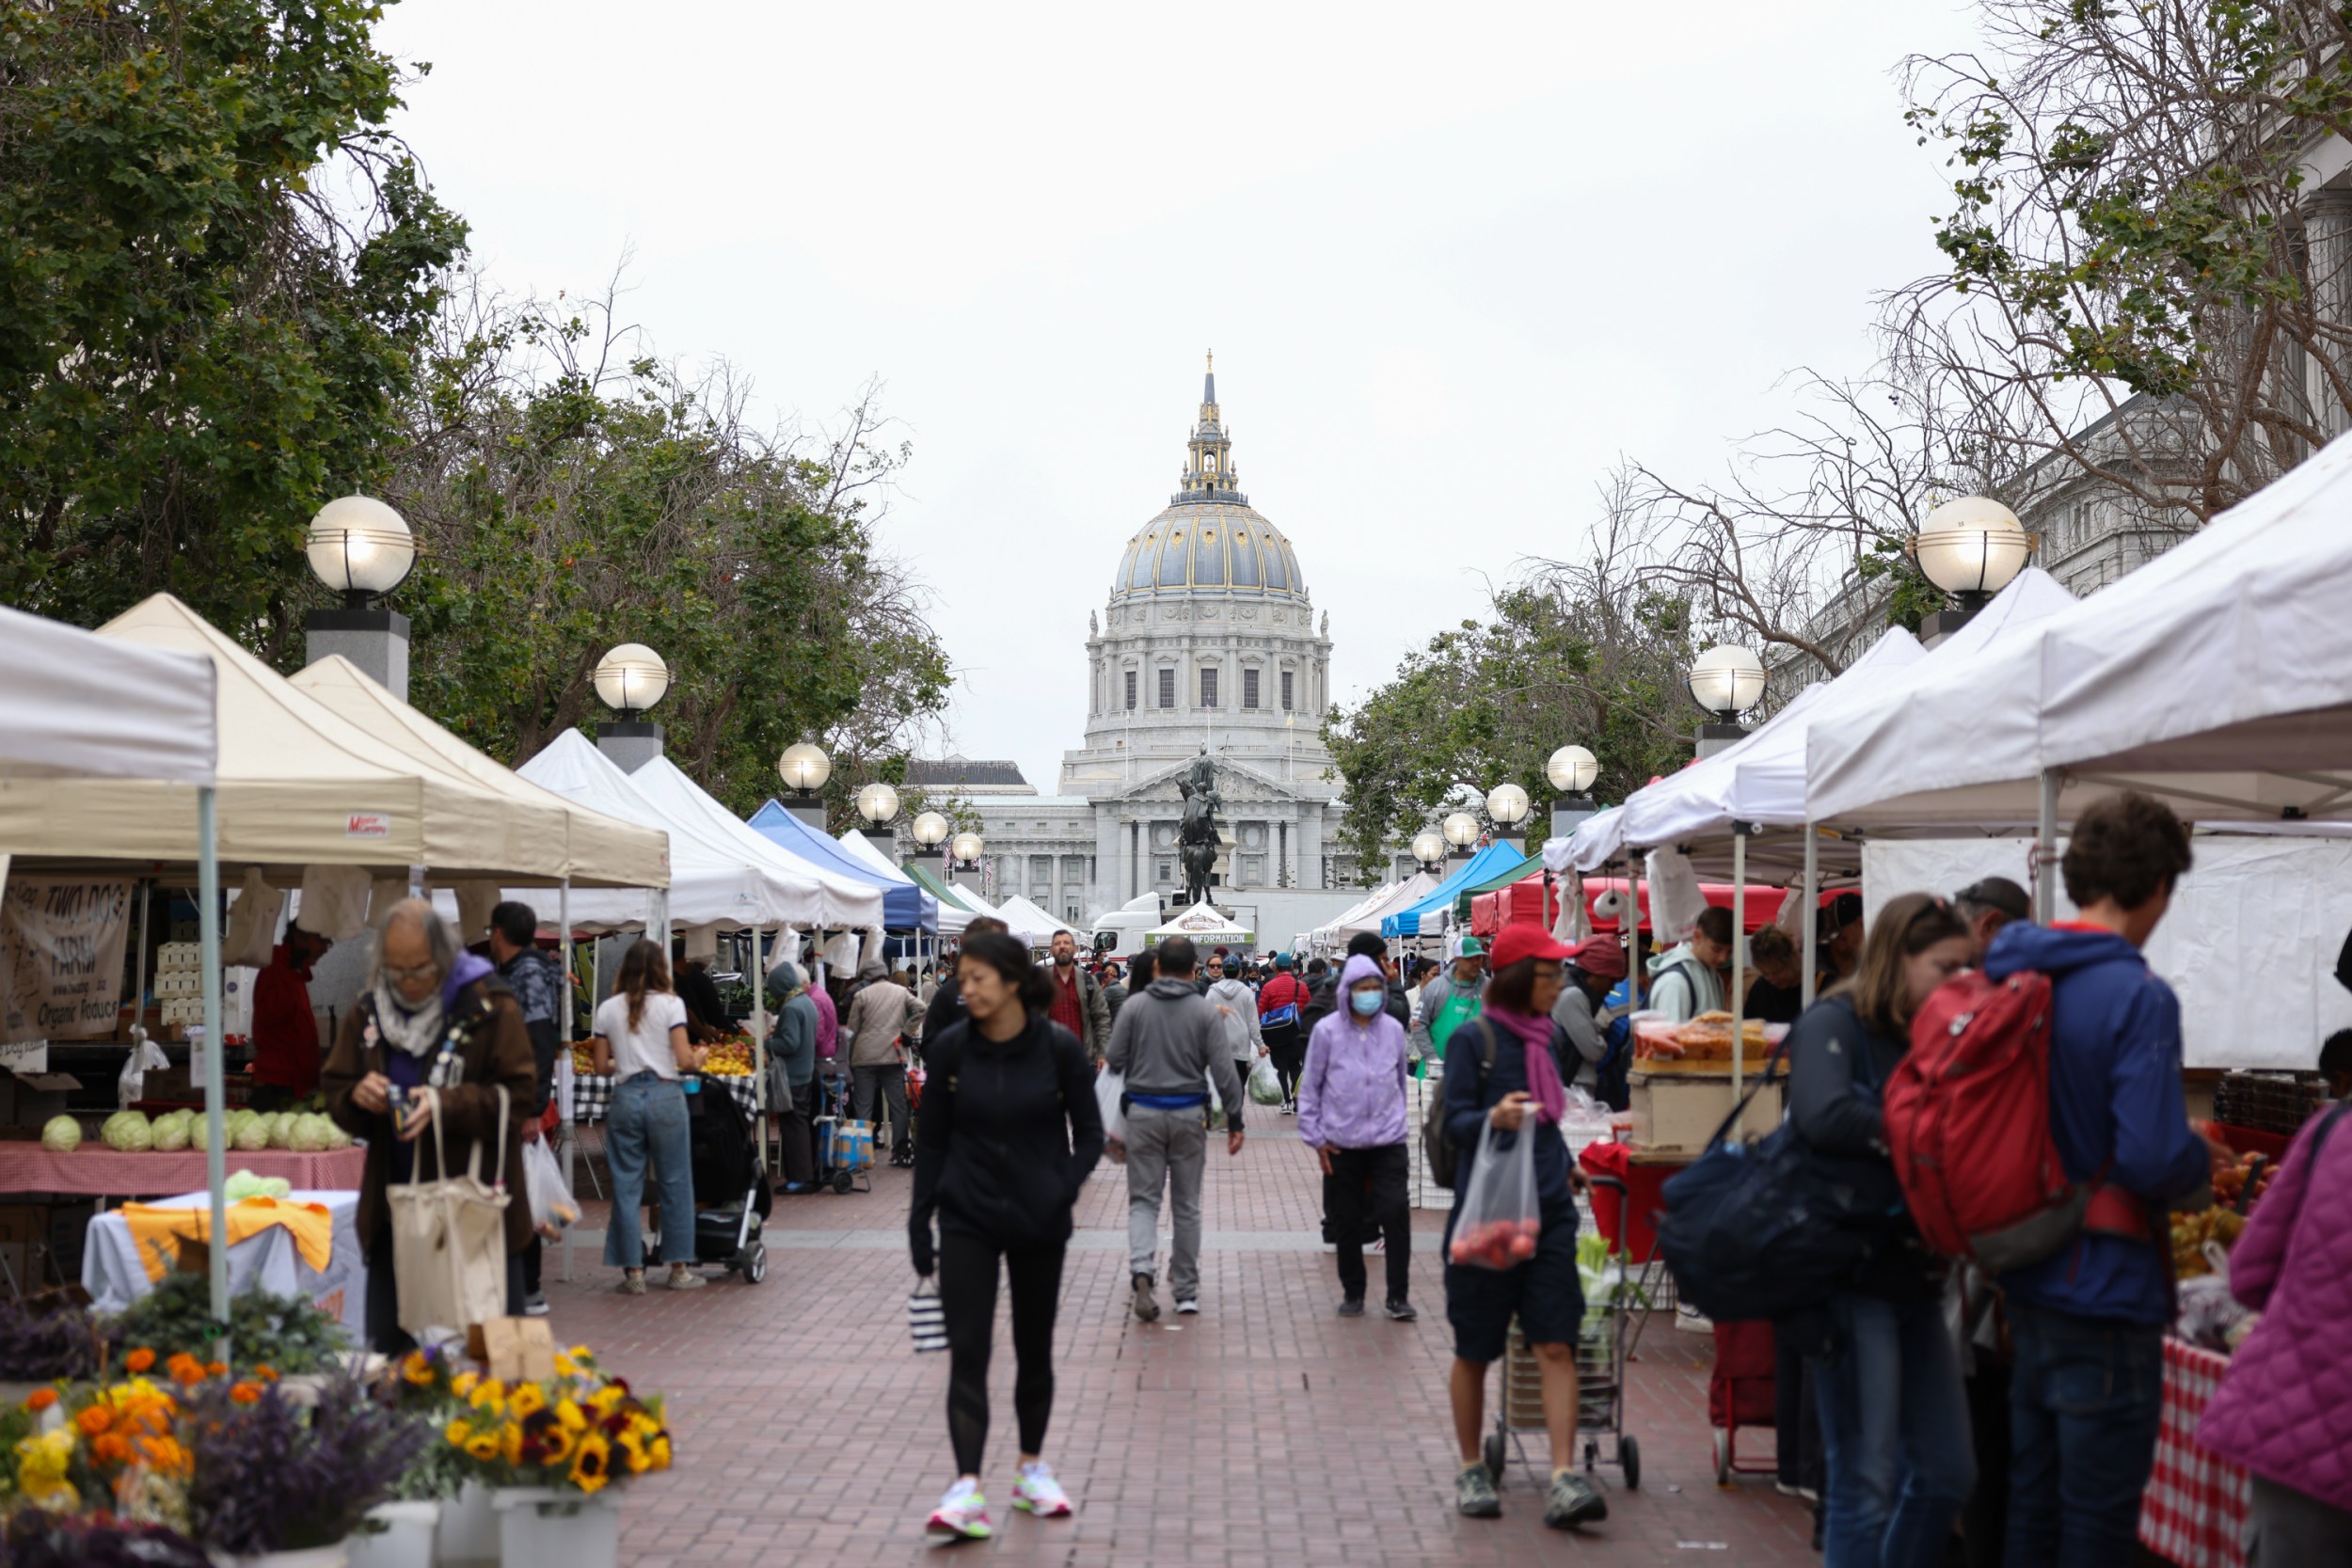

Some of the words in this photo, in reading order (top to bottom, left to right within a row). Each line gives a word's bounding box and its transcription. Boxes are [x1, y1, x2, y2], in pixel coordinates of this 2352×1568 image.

[45, 885, 83, 924] TWO
[1190, 934, 1245, 943] INFORMATION
[52, 936, 95, 976] FARM
[38, 1001, 76, 1029] Organic
